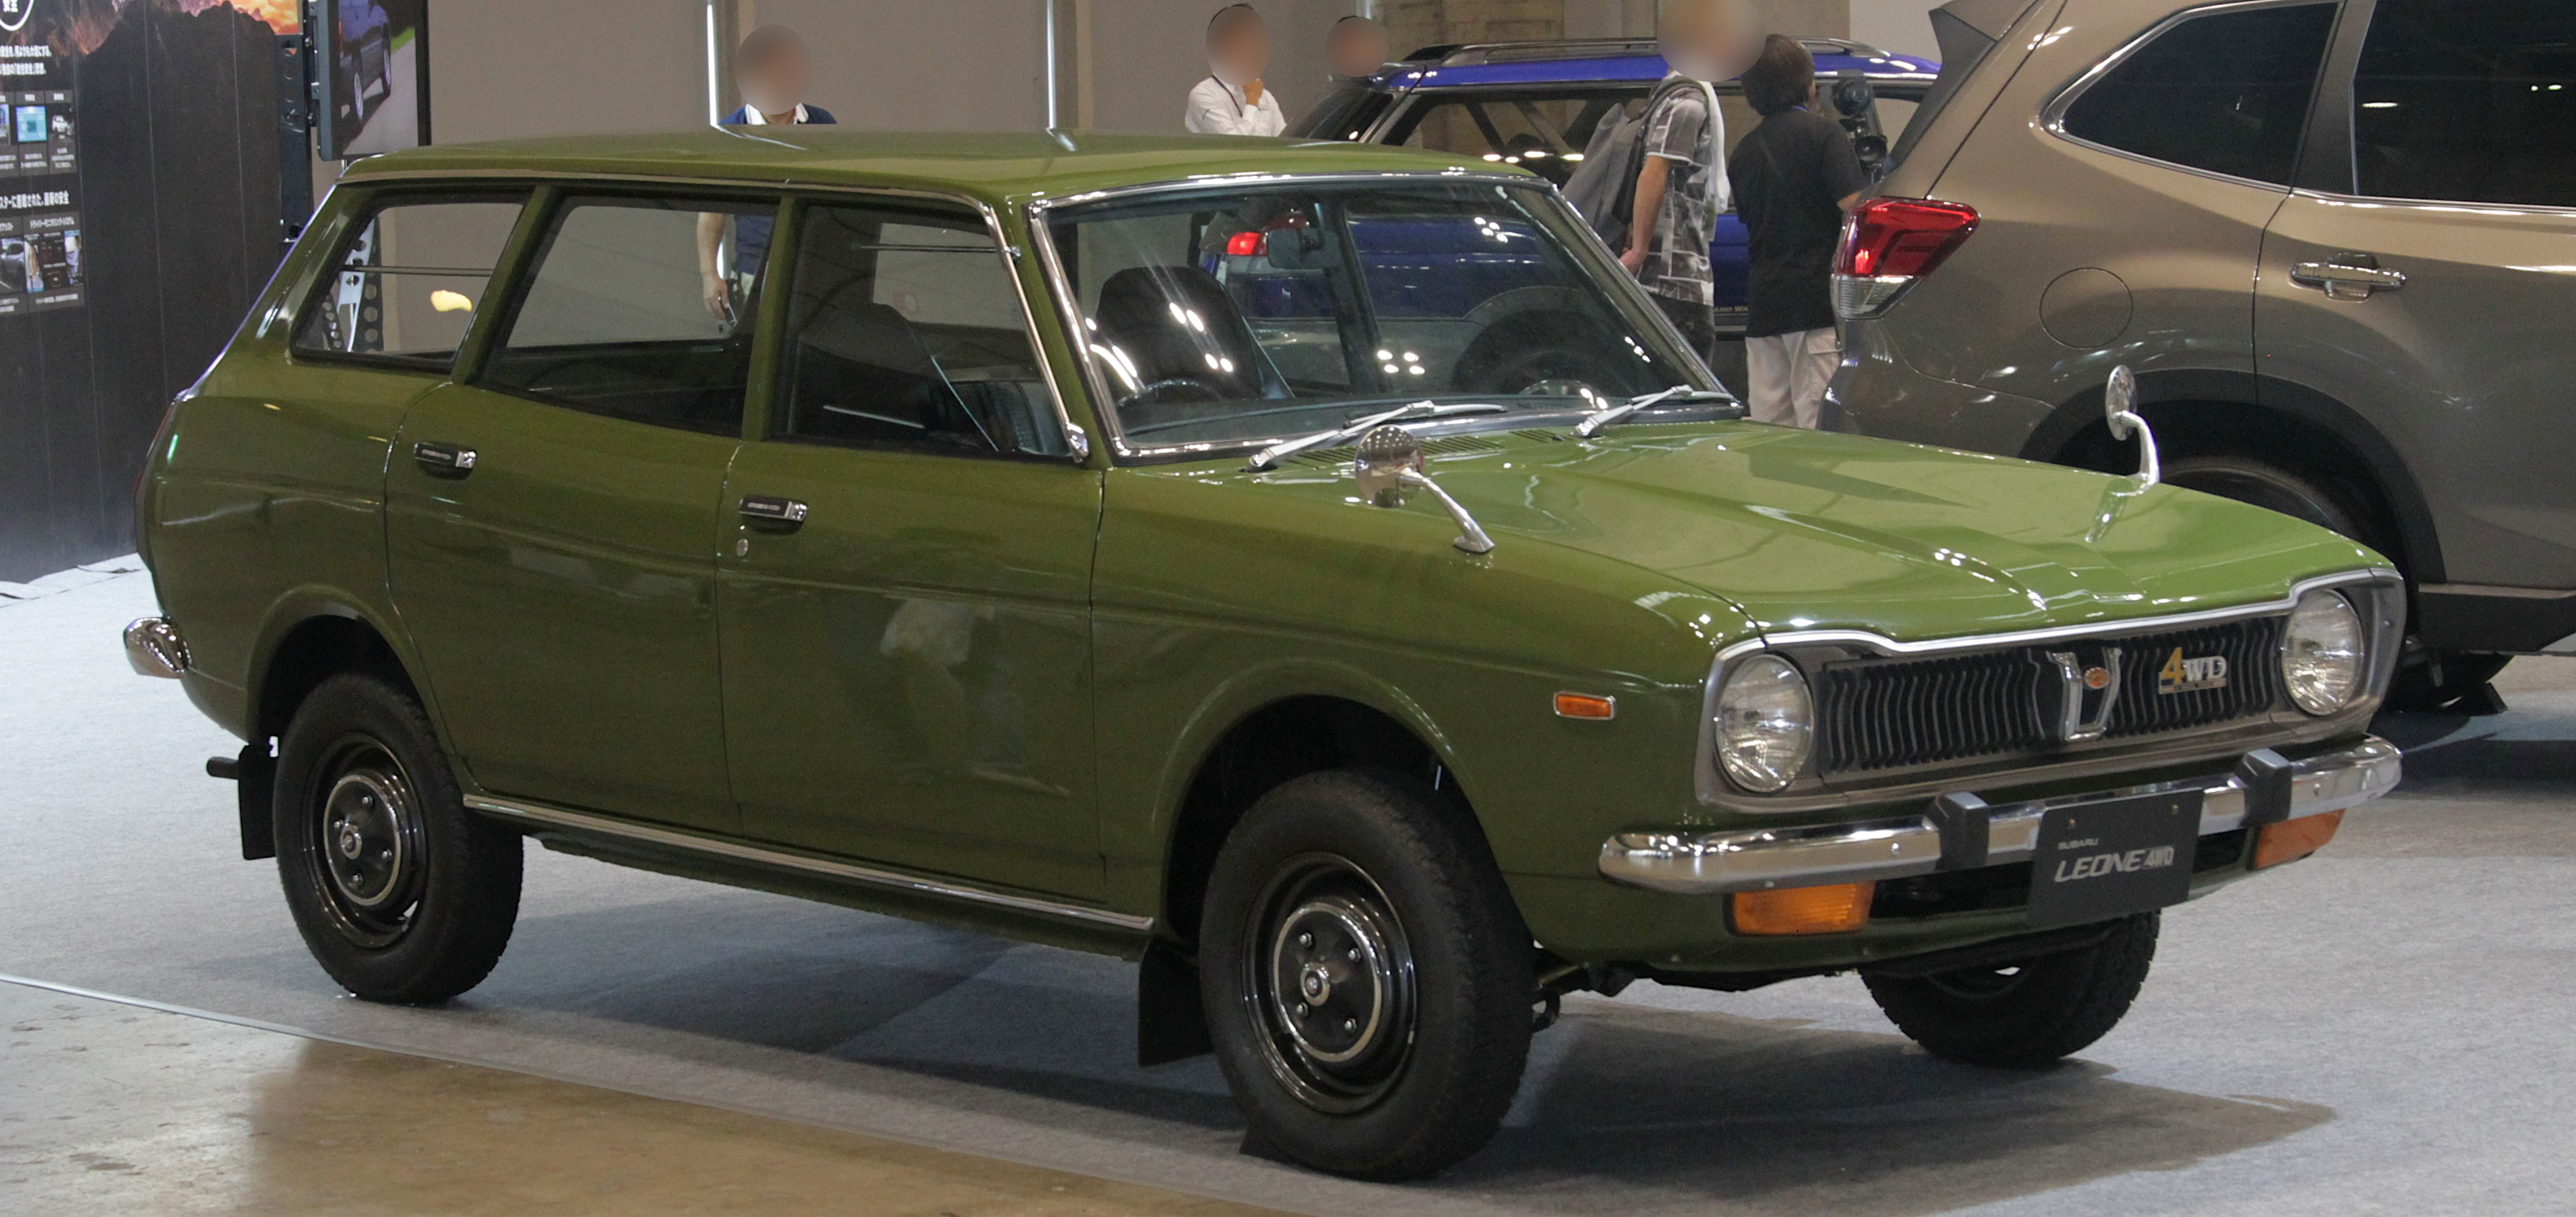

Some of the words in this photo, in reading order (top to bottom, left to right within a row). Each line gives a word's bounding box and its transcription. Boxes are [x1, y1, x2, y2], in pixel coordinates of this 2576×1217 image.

[2162, 647, 2228, 684] 4WD
[2058, 838, 2099, 850] SUBARU
[2054, 849, 2146, 882] LEONE
[2144, 846, 2175, 867] 4WD
